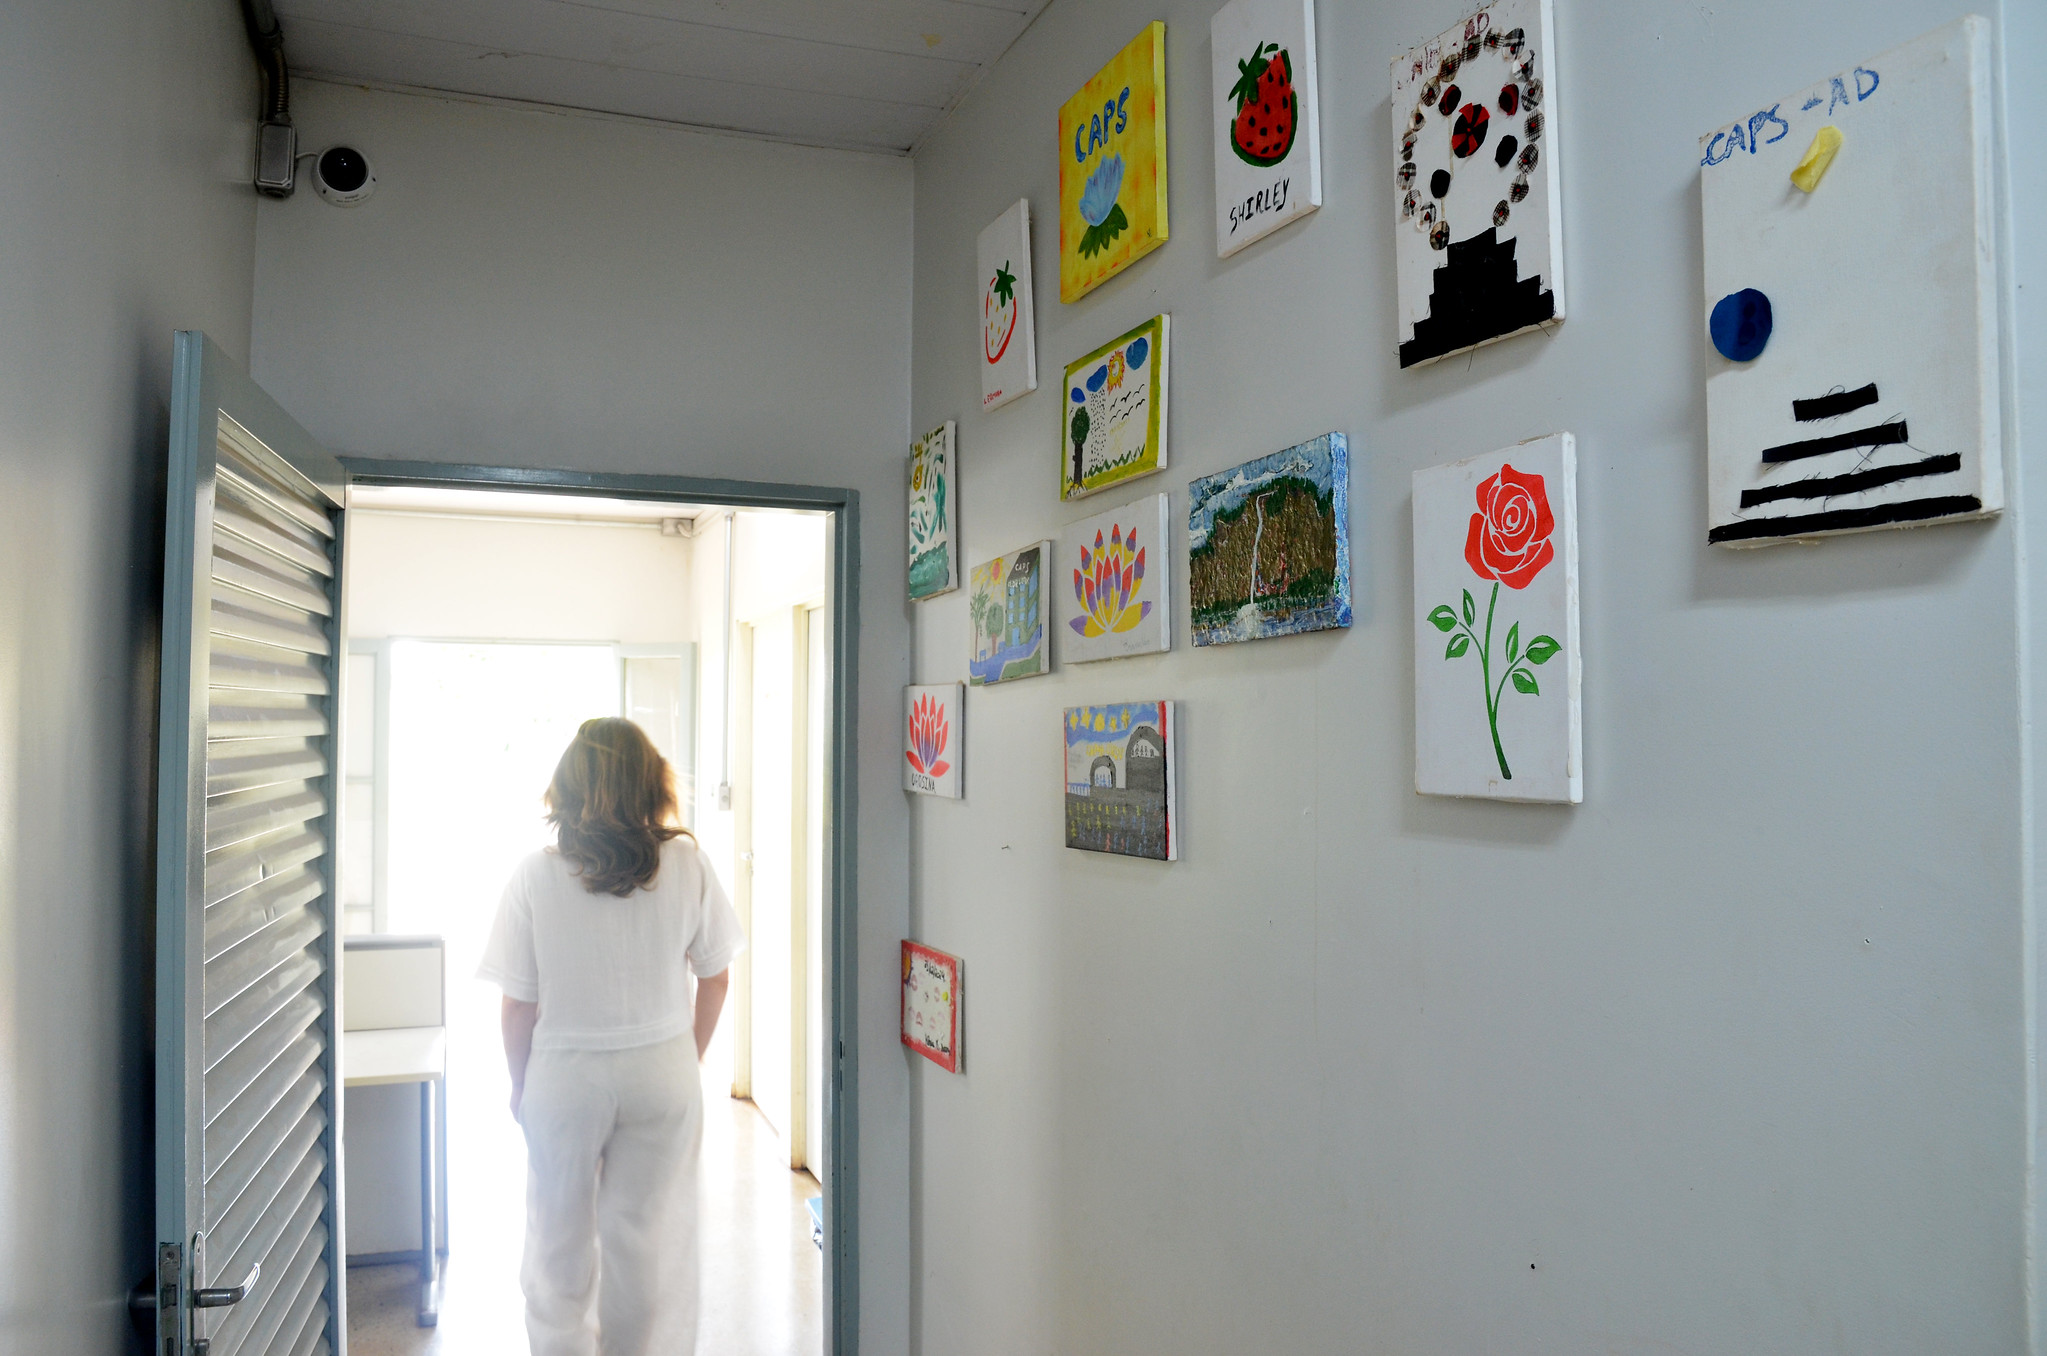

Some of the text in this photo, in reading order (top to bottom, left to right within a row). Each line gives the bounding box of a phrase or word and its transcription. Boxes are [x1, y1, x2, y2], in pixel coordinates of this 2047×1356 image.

[1075, 86, 1130, 163] CAPS
[1701, 103, 1789, 167] CAPS
[1229, 177, 1290, 236] SHIRLEY
